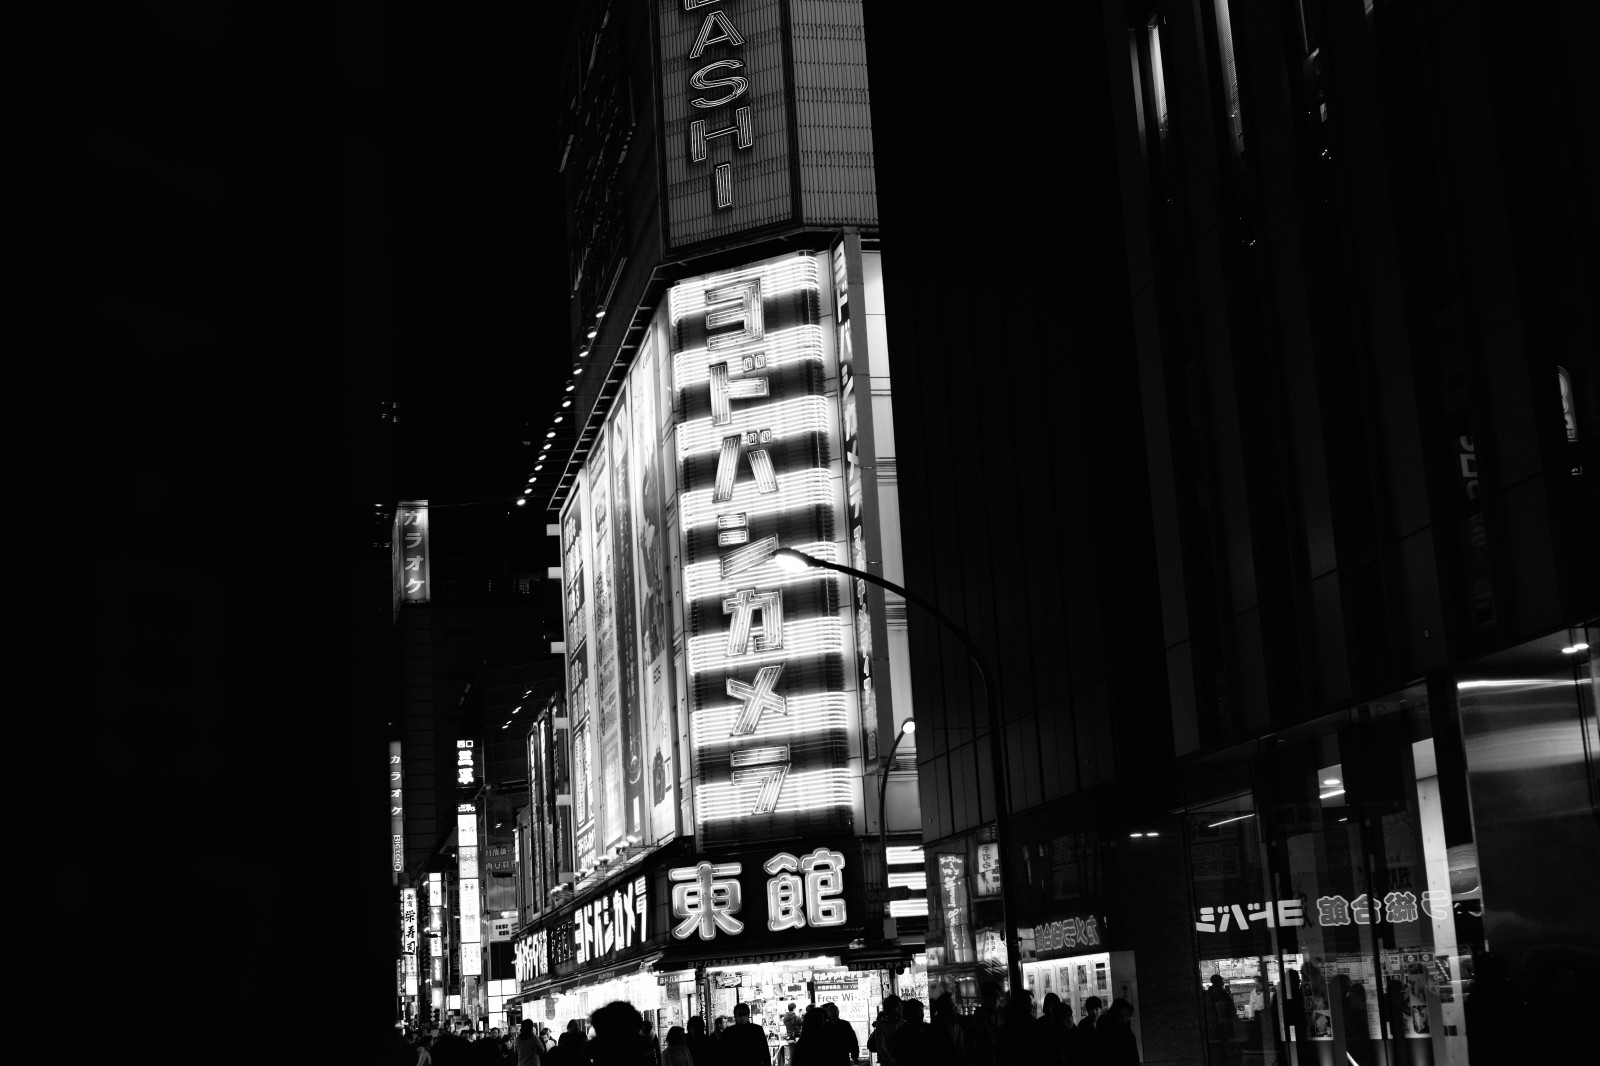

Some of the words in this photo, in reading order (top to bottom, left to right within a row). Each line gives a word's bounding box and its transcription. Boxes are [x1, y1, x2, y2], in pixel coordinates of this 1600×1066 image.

[685, 0, 753, 208] ASHI
[834, 241, 862, 518] ヨドバシカメラ
[404, 510, 425, 594] カラオケ
[703, 278, 792, 815] ヨドバシカメラ
[390, 755, 402, 816] カラオケ
[393, 834, 401, 849] BIG
[394, 850, 402, 872] ECHO
[574, 875, 647, 964] ヨドバシカメラ
[668, 847, 847, 940] 東館
[687, 957, 744, 969] ヨドバシカメラ
[817, 993, 839, 1003] Free
[850, 960, 910, 971] ヨドバシカメラ
